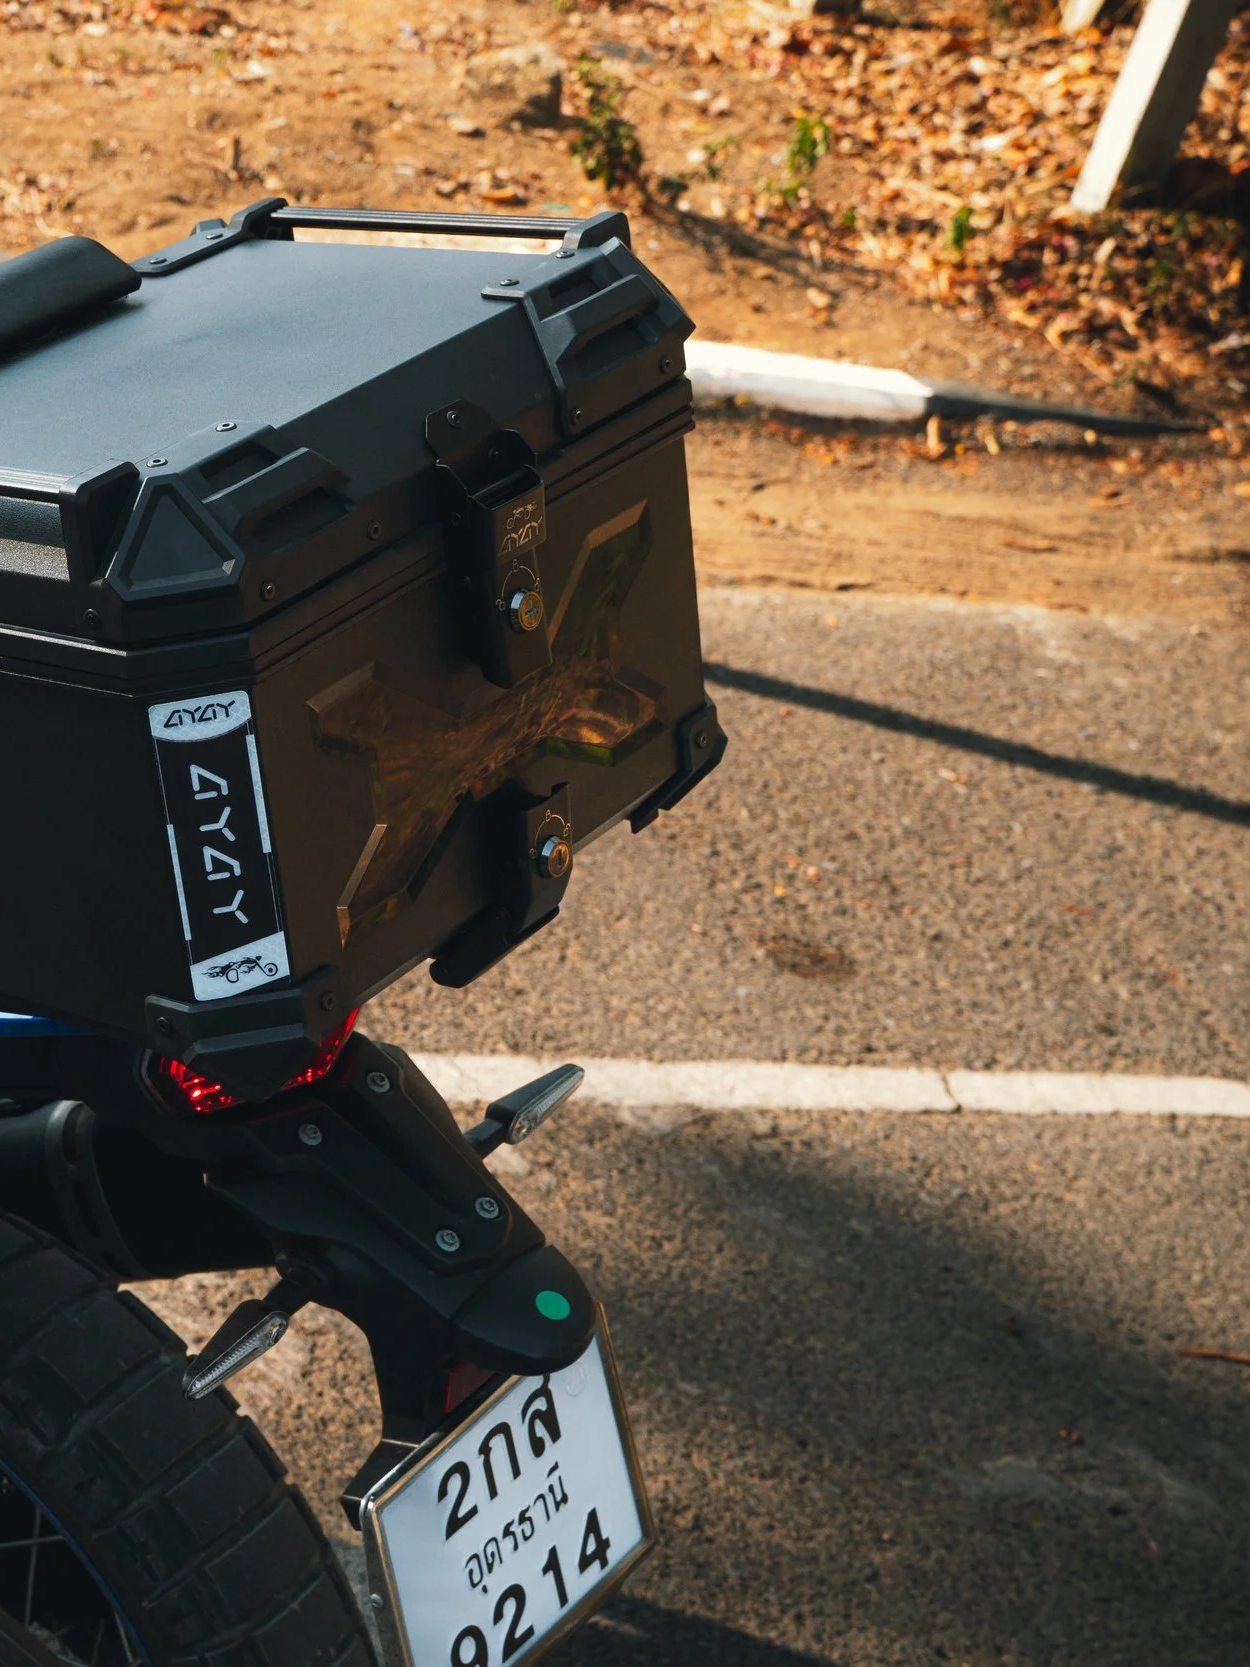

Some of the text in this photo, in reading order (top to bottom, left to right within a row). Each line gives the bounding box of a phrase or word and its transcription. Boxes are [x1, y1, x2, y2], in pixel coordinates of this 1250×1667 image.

[437, 1374, 562, 1541] 2กส
[463, 1460, 570, 1595] อุดรธานี
